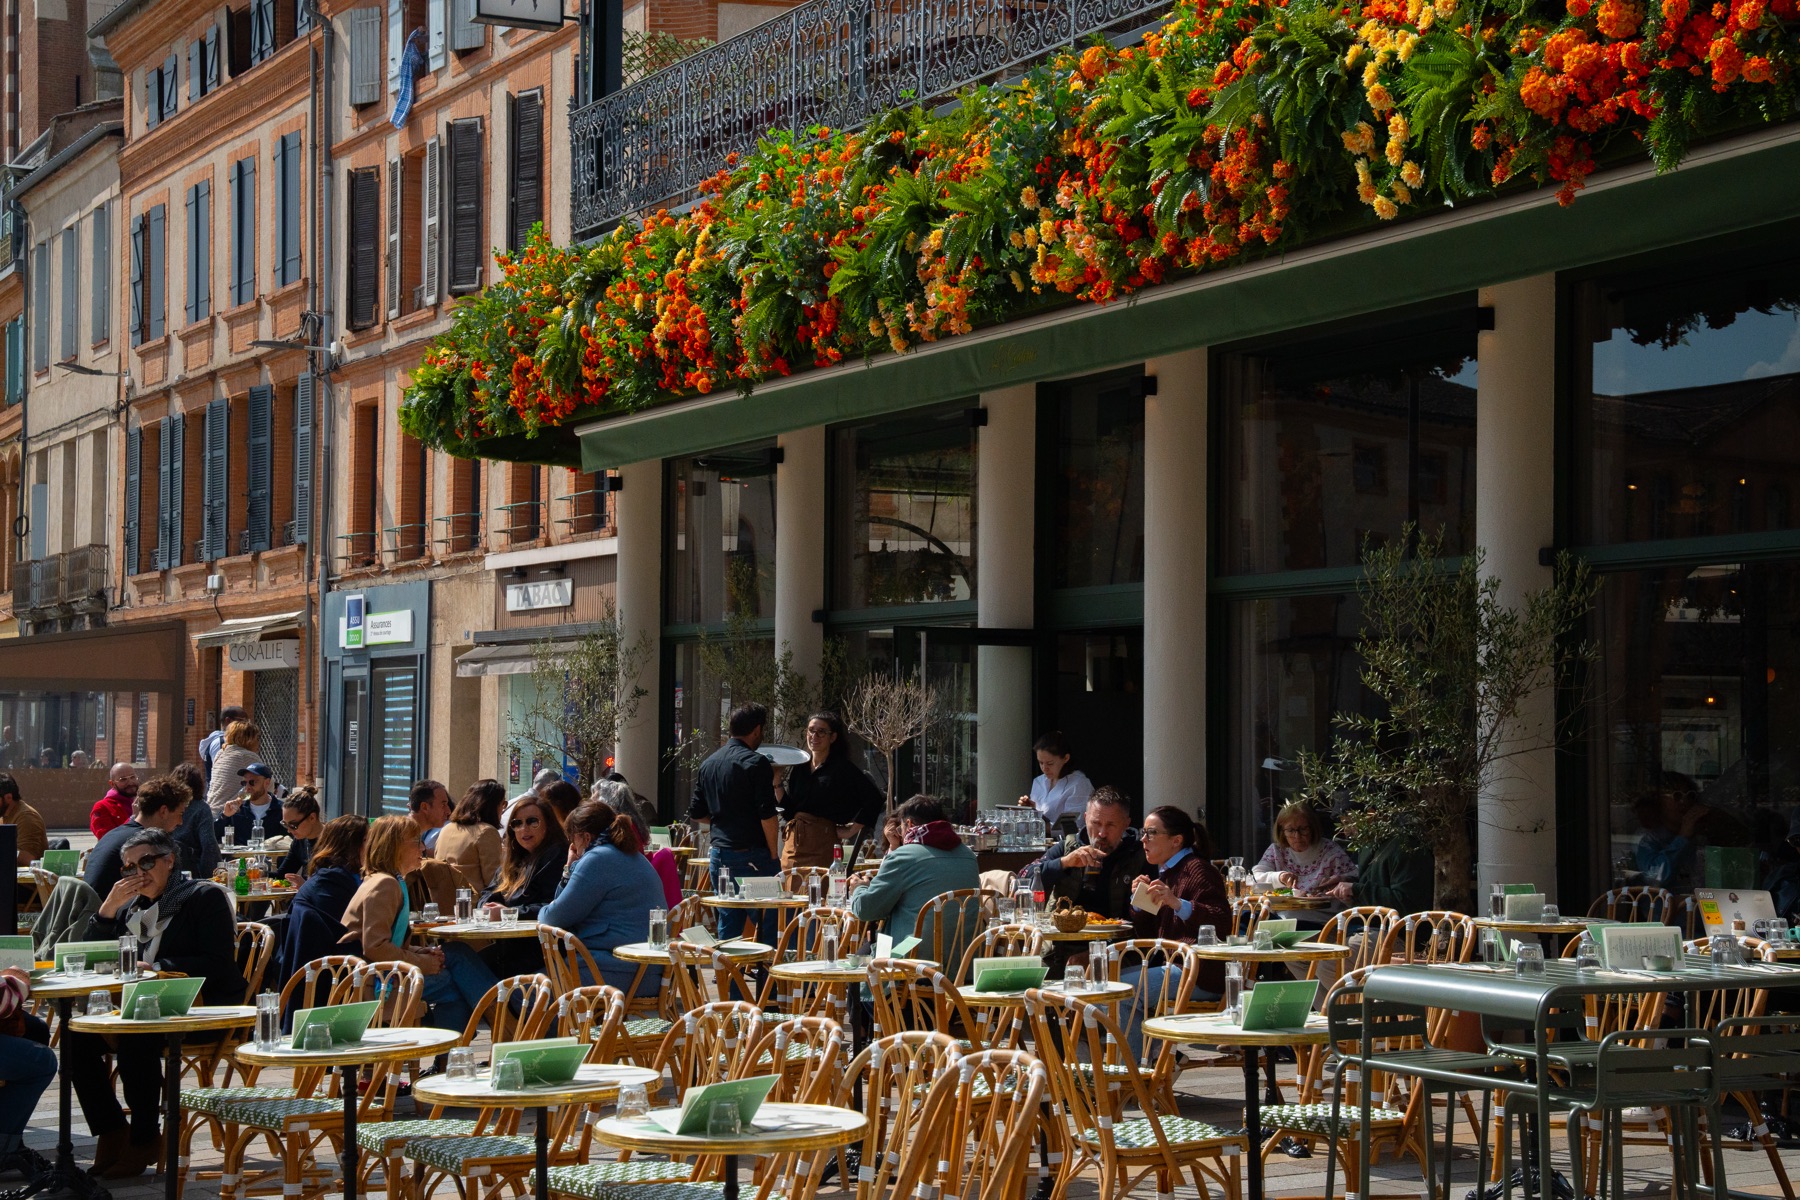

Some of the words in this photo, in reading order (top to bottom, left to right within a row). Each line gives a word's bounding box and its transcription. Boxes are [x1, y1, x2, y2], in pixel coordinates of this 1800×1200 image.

[514, 581, 562, 607] TABAC
[350, 616, 360, 625] ASSU
[370, 620, 392, 629] Assurances
[349, 633, 360, 642] 2000
[230, 642, 282, 662] CORALIE
